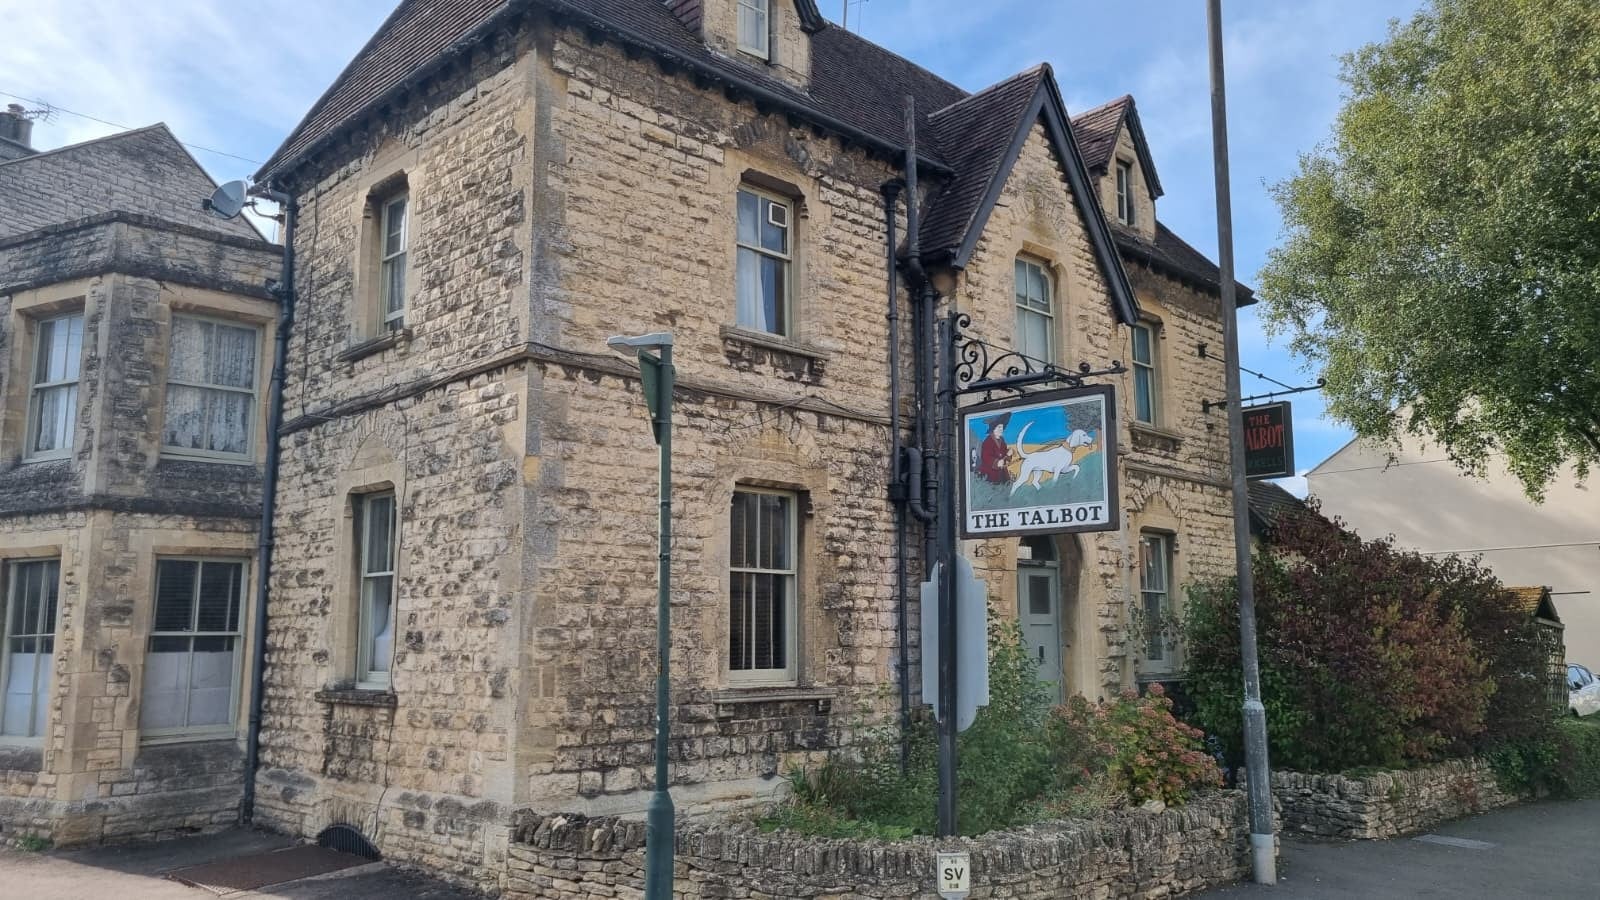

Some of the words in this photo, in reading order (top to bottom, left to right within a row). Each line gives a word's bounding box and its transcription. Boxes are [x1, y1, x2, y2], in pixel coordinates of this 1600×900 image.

[1248, 414, 1270, 426] THE
[1245, 424, 1284, 451] ALBOT
[972, 512, 1009, 529] THE
[1018, 506, 1102, 526] TALBOT
[944, 867, 964, 881] SV
